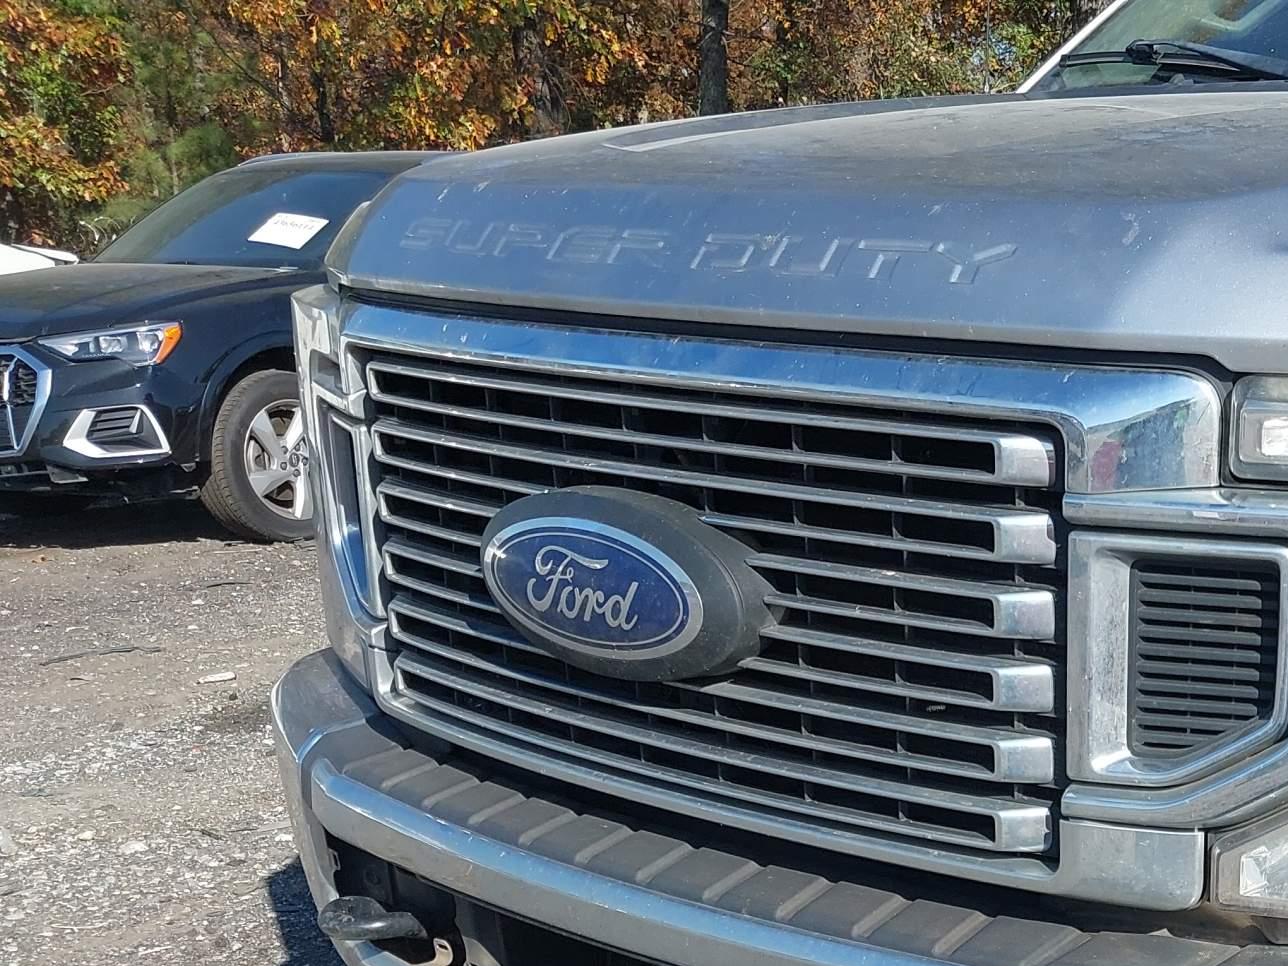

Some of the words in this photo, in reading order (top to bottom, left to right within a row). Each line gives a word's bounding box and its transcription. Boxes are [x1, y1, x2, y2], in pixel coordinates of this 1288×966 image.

[400, 217, 672, 273] SUPER
[689, 233, 1018, 285] DUTY
[526, 545, 639, 632] Ford
